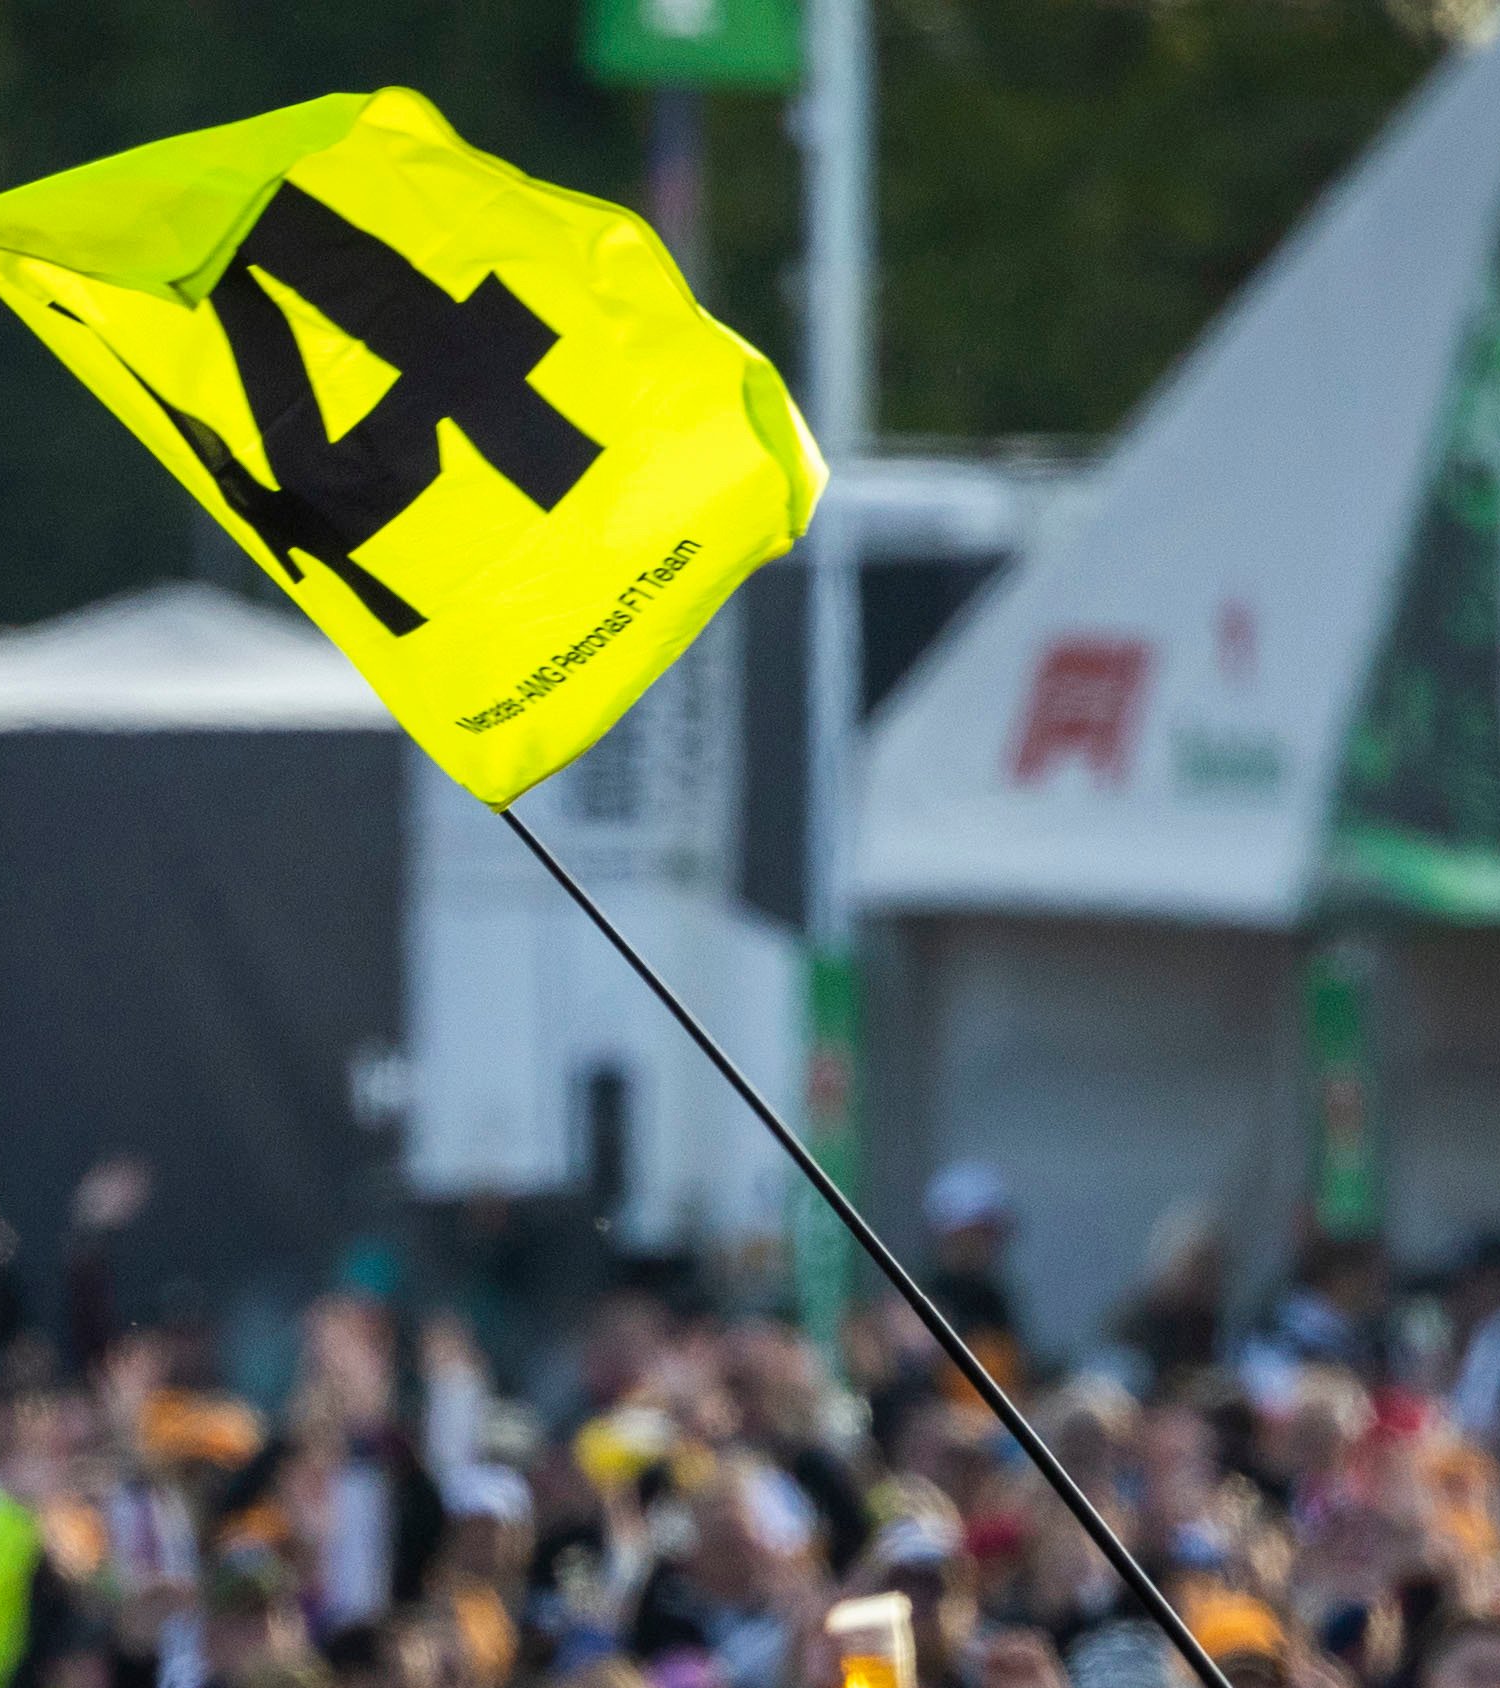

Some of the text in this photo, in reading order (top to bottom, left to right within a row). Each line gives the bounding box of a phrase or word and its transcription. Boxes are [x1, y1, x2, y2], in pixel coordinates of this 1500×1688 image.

[636, 539, 703, 589] Team
[618, 587, 655, 613] F1
[551, 610, 633, 673] Petronas
